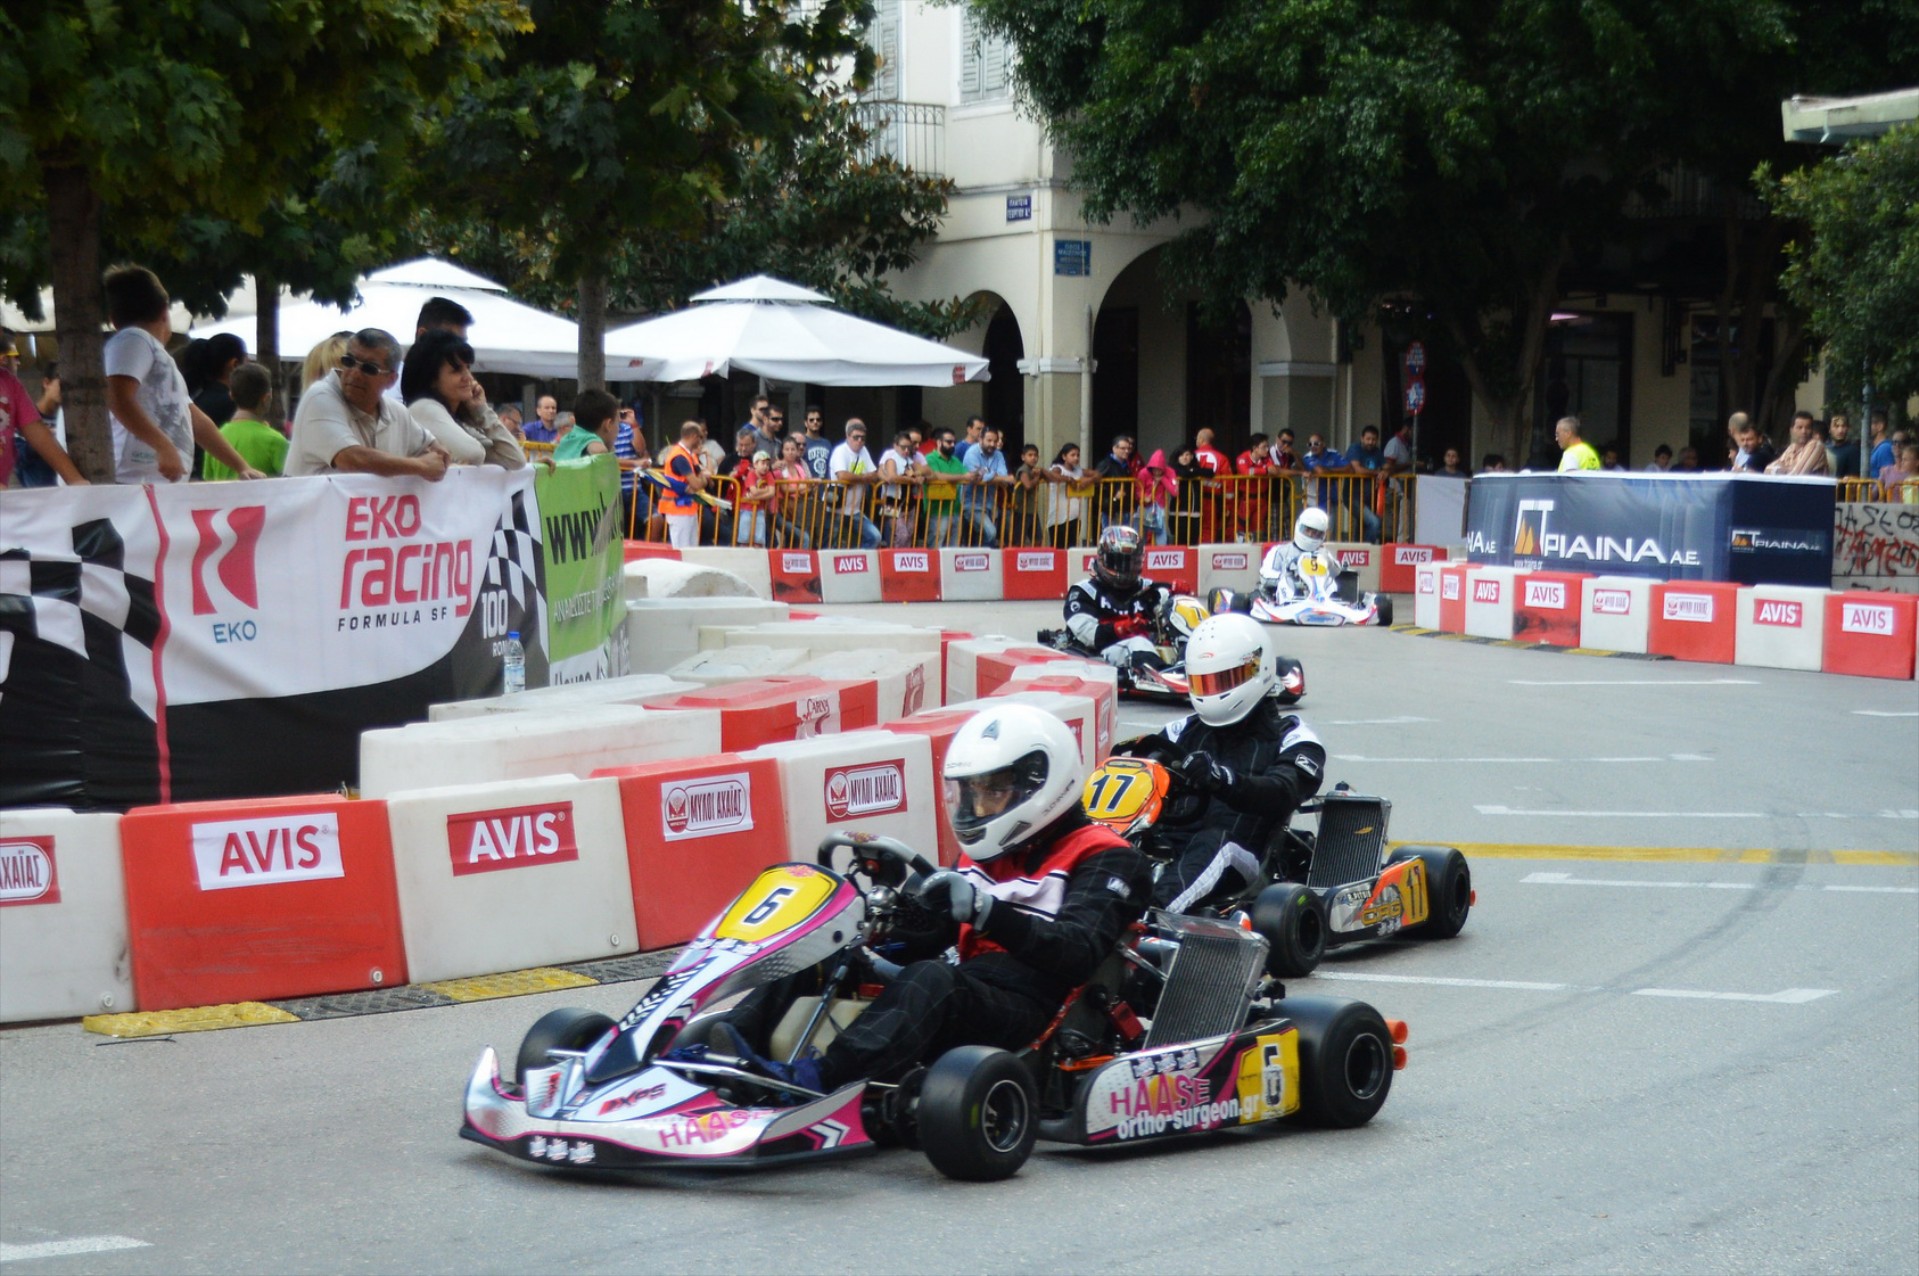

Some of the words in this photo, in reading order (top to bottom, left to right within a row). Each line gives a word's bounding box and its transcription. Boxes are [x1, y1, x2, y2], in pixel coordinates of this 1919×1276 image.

[345, 495, 422, 541] EKO
[340, 539, 473, 618] racing
[213, 620, 257, 644] EKO
[337, 609, 423, 632] FORMULA
[431, 606, 448, 621] SF
[481, 588, 509, 639] 100
[1086, 773, 1137, 813] 17
[0, 849, 43, 890] ΧΑΪΑΣ
[743, 886, 798, 926] 6
[1110, 1072, 1211, 1119] HAASE
[1117, 1094, 1261, 1140] ortho-surgeon.gr
